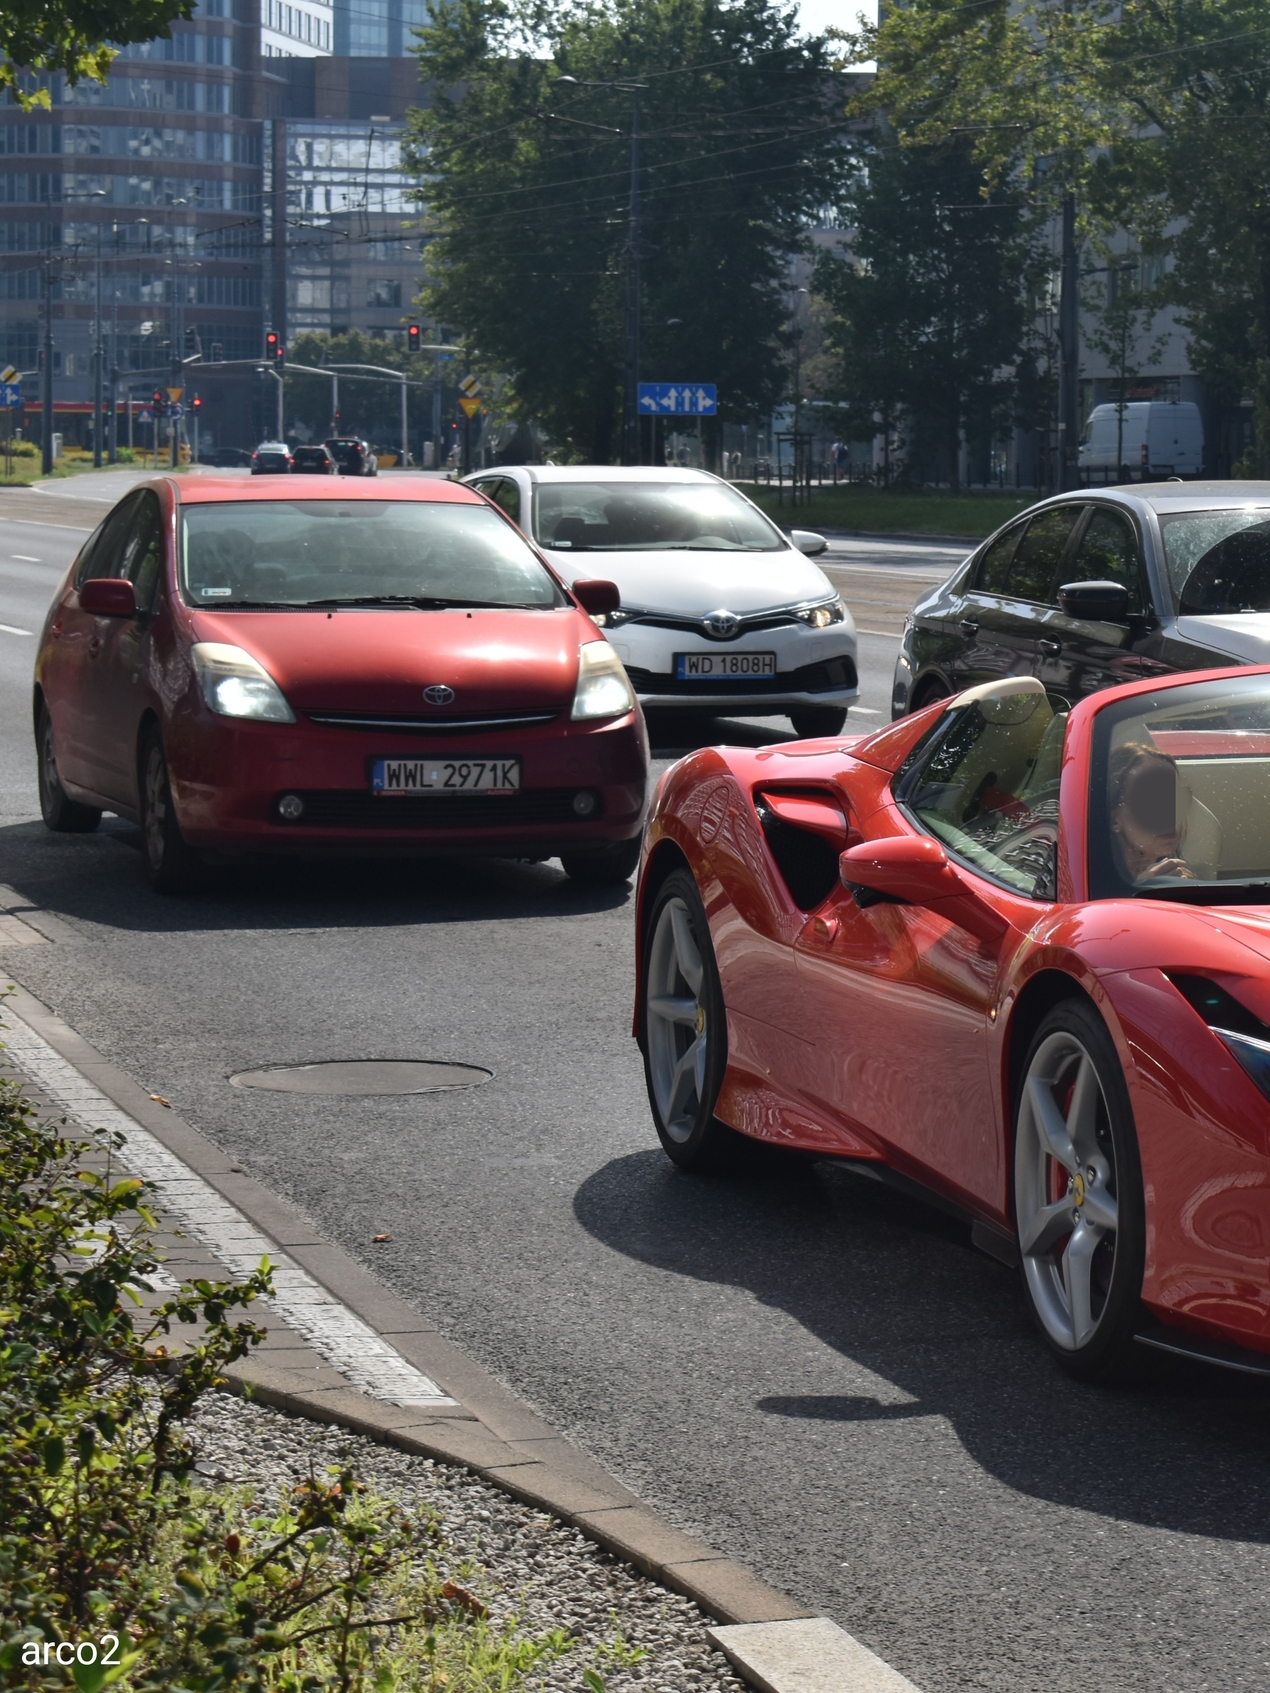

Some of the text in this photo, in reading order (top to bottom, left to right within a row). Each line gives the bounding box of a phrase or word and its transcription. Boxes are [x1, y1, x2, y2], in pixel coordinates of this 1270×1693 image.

[688, 657, 773, 674] WD 1808H
[386, 763, 516, 788] WWL 2971K
